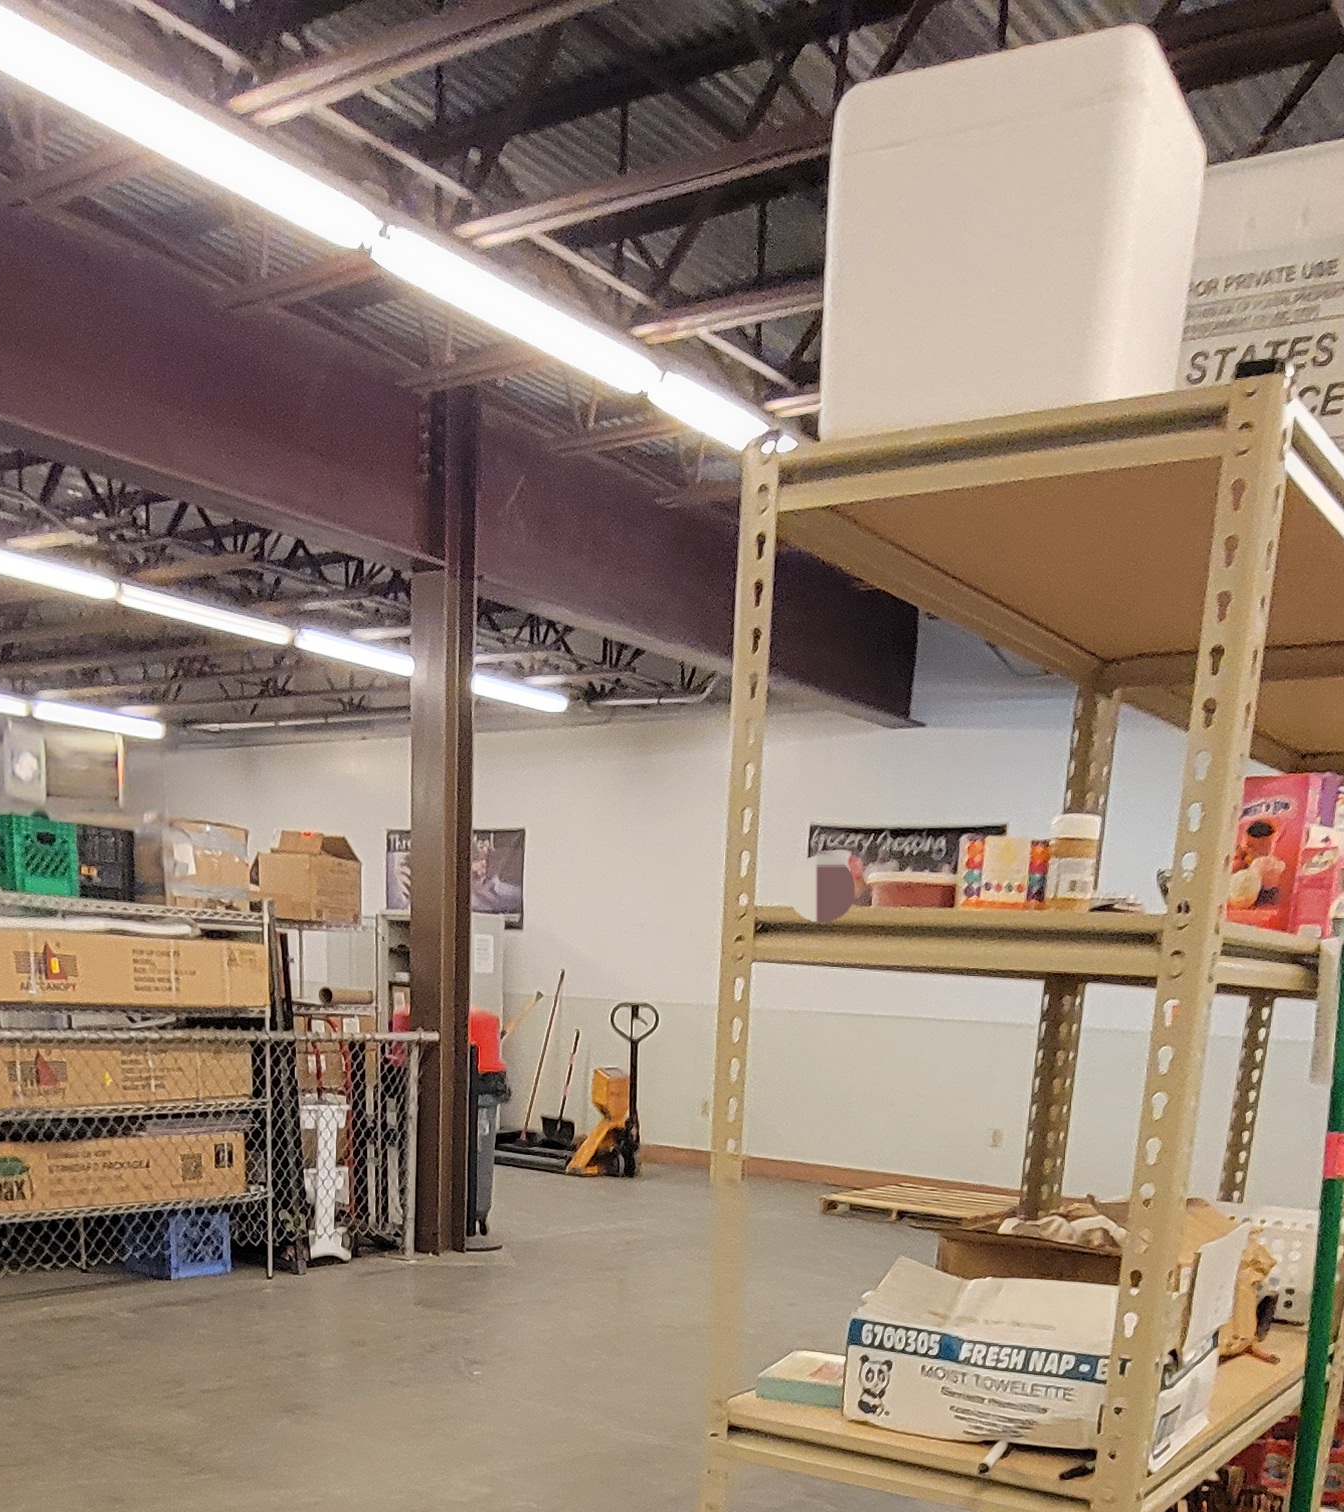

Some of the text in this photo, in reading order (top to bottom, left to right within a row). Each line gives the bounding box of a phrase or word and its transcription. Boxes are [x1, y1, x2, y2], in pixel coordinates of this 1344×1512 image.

[1223, 264, 1297, 293] PRIVATE
[1301, 257, 1340, 281] USE
[861, 1322, 941, 1356] 6700305
[959, 1340, 1026, 1371] FRESH
[1028, 1349, 1076, 1376] NAP
[920, 1364, 968, 1386] MOIST
[973, 1373, 1076, 1402] TOWELETTE
